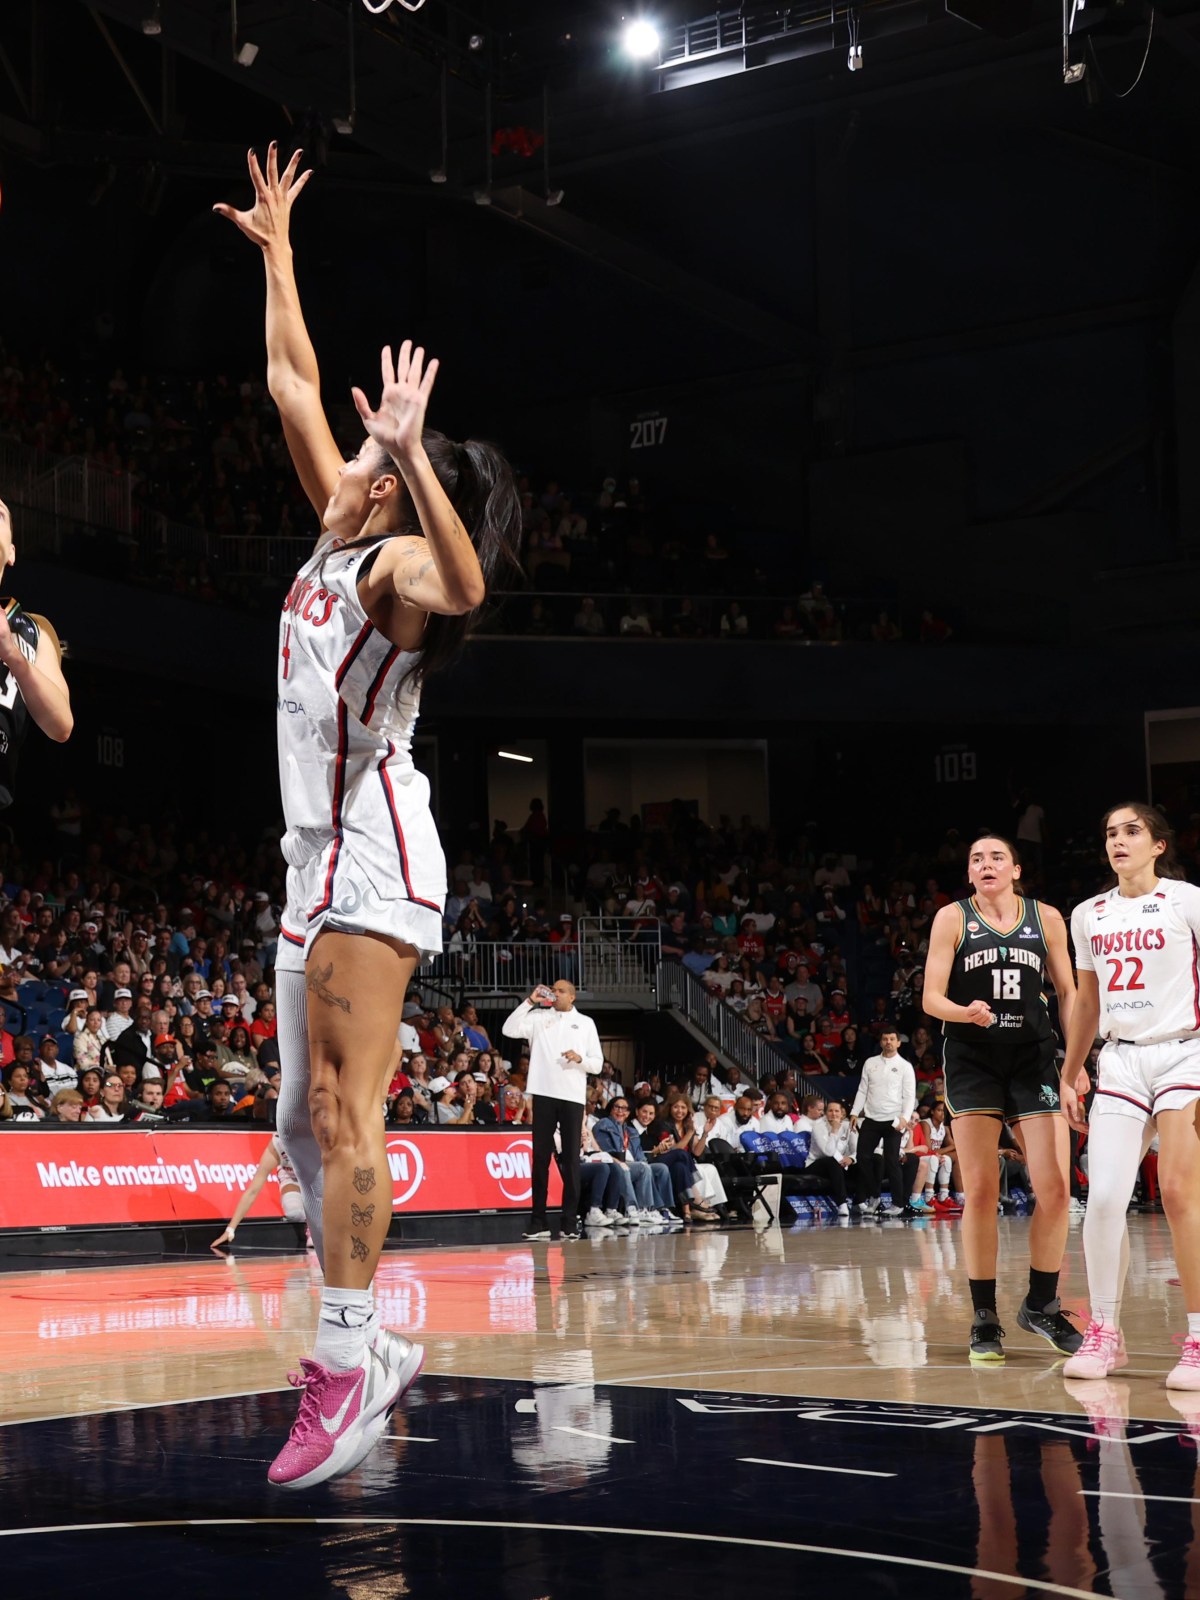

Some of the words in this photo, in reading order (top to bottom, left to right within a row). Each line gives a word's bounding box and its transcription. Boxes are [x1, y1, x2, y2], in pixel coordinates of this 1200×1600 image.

[630, 417, 668, 449] 207
[97, 735, 125, 768] 108
[934, 752, 977, 783] 109
[964, 947, 998, 973] NEW
[1106, 957, 1146, 992] 22
[991, 969, 1021, 1000] 18
[36, 1160, 101, 1188] Make
[102, 1157, 197, 1192] amazing
[486, 1152, 532, 1179] CDW
